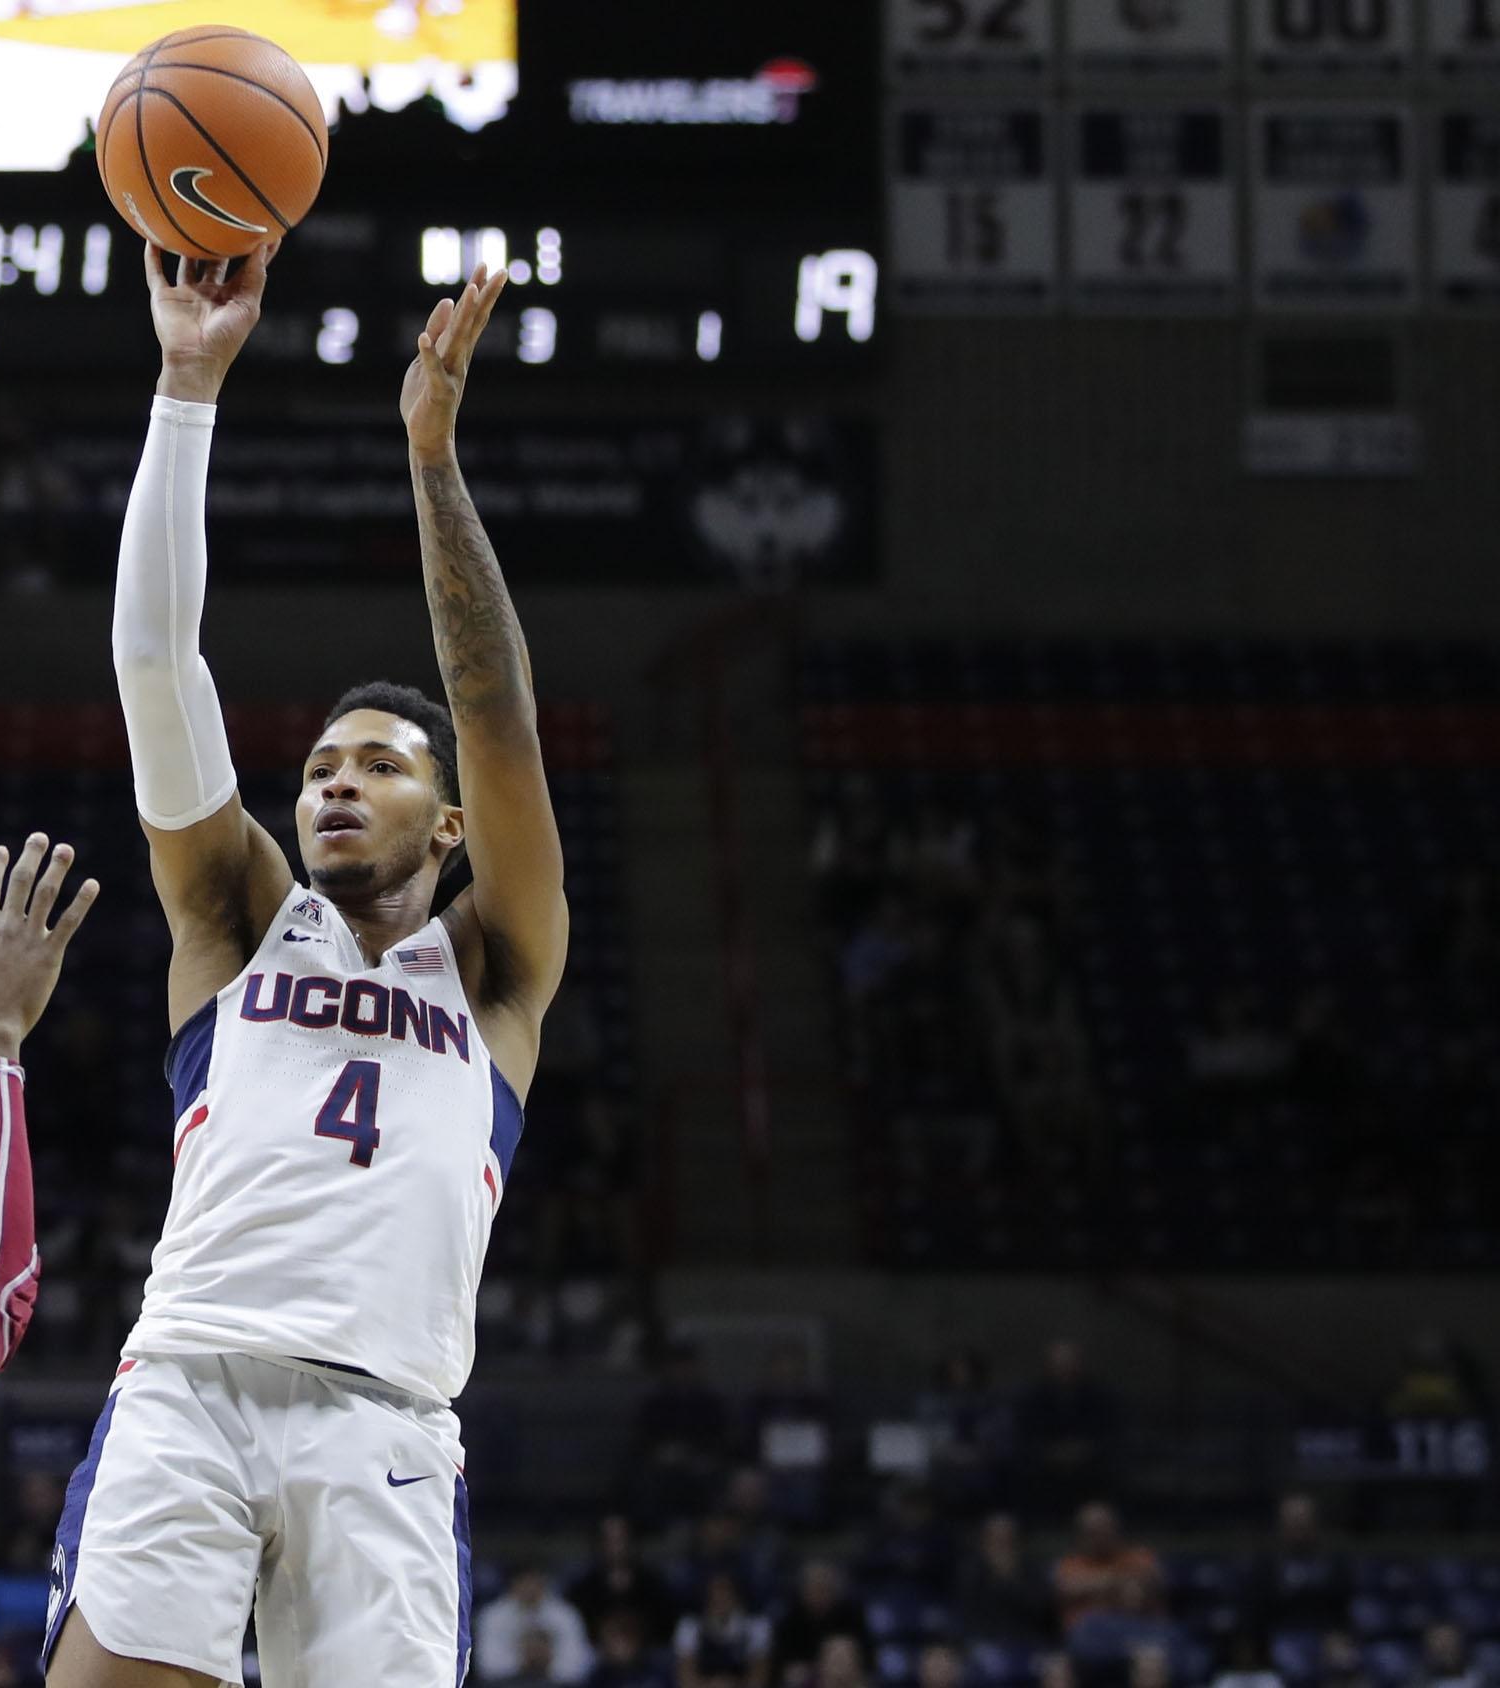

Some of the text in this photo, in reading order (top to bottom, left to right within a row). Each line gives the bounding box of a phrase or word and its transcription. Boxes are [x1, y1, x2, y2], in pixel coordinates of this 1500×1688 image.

[944, 193, 1003, 265] 15
[1116, 192, 1189, 267] 22
[794, 248, 878, 343] 19
[315, 307, 360, 364] 2
[516, 306, 557, 364] 3
[239, 972, 470, 1064] UCONN
[314, 1060, 381, 1168] 4
